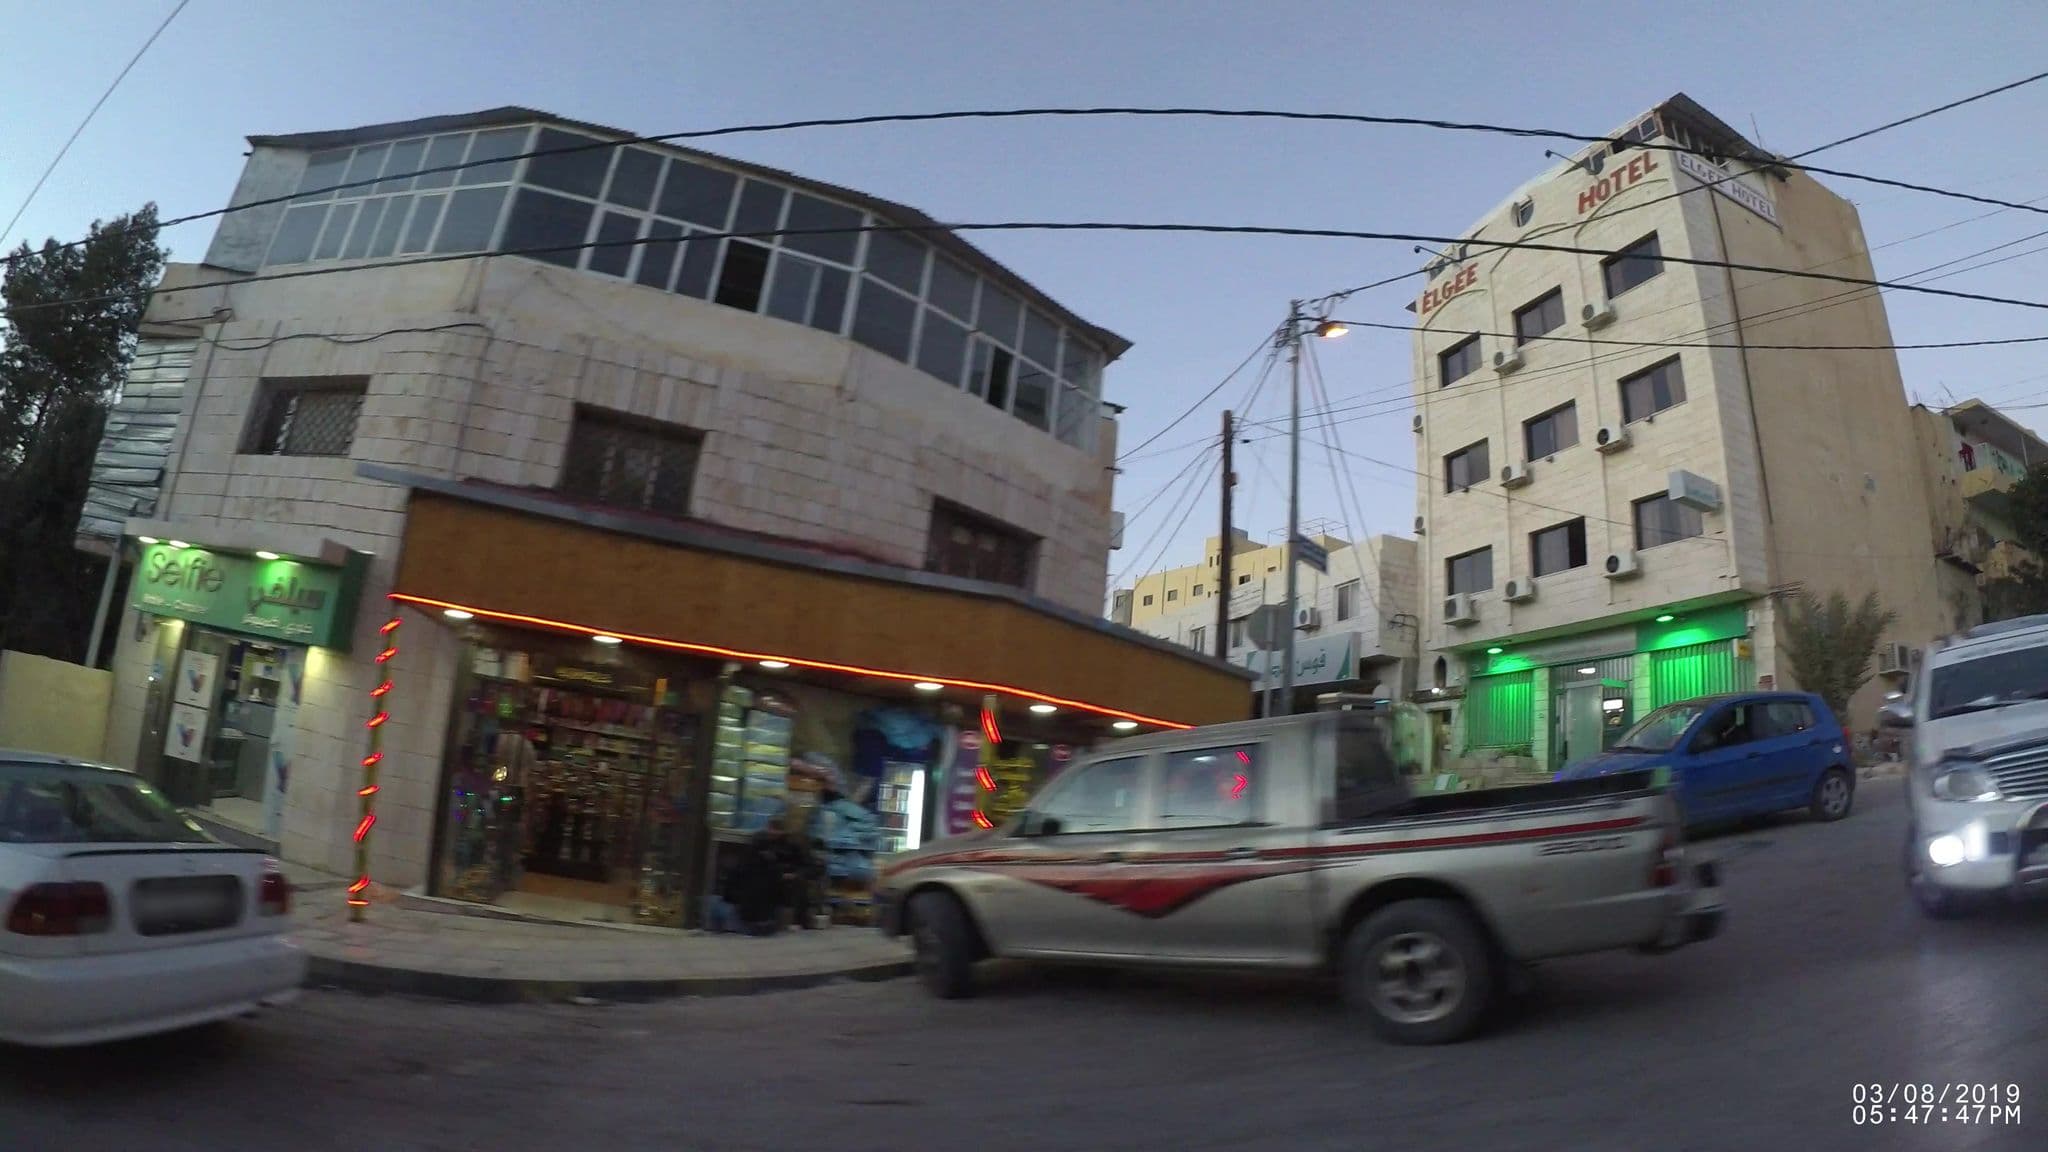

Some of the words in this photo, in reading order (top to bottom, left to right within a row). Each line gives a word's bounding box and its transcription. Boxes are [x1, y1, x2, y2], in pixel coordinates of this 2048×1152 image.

[1578, 151, 1659, 215] HOTEL
[1731, 183, 1776, 218] HOTEL
[1422, 262, 1479, 315] ELGEE
[147, 552, 224, 592] Selfie
